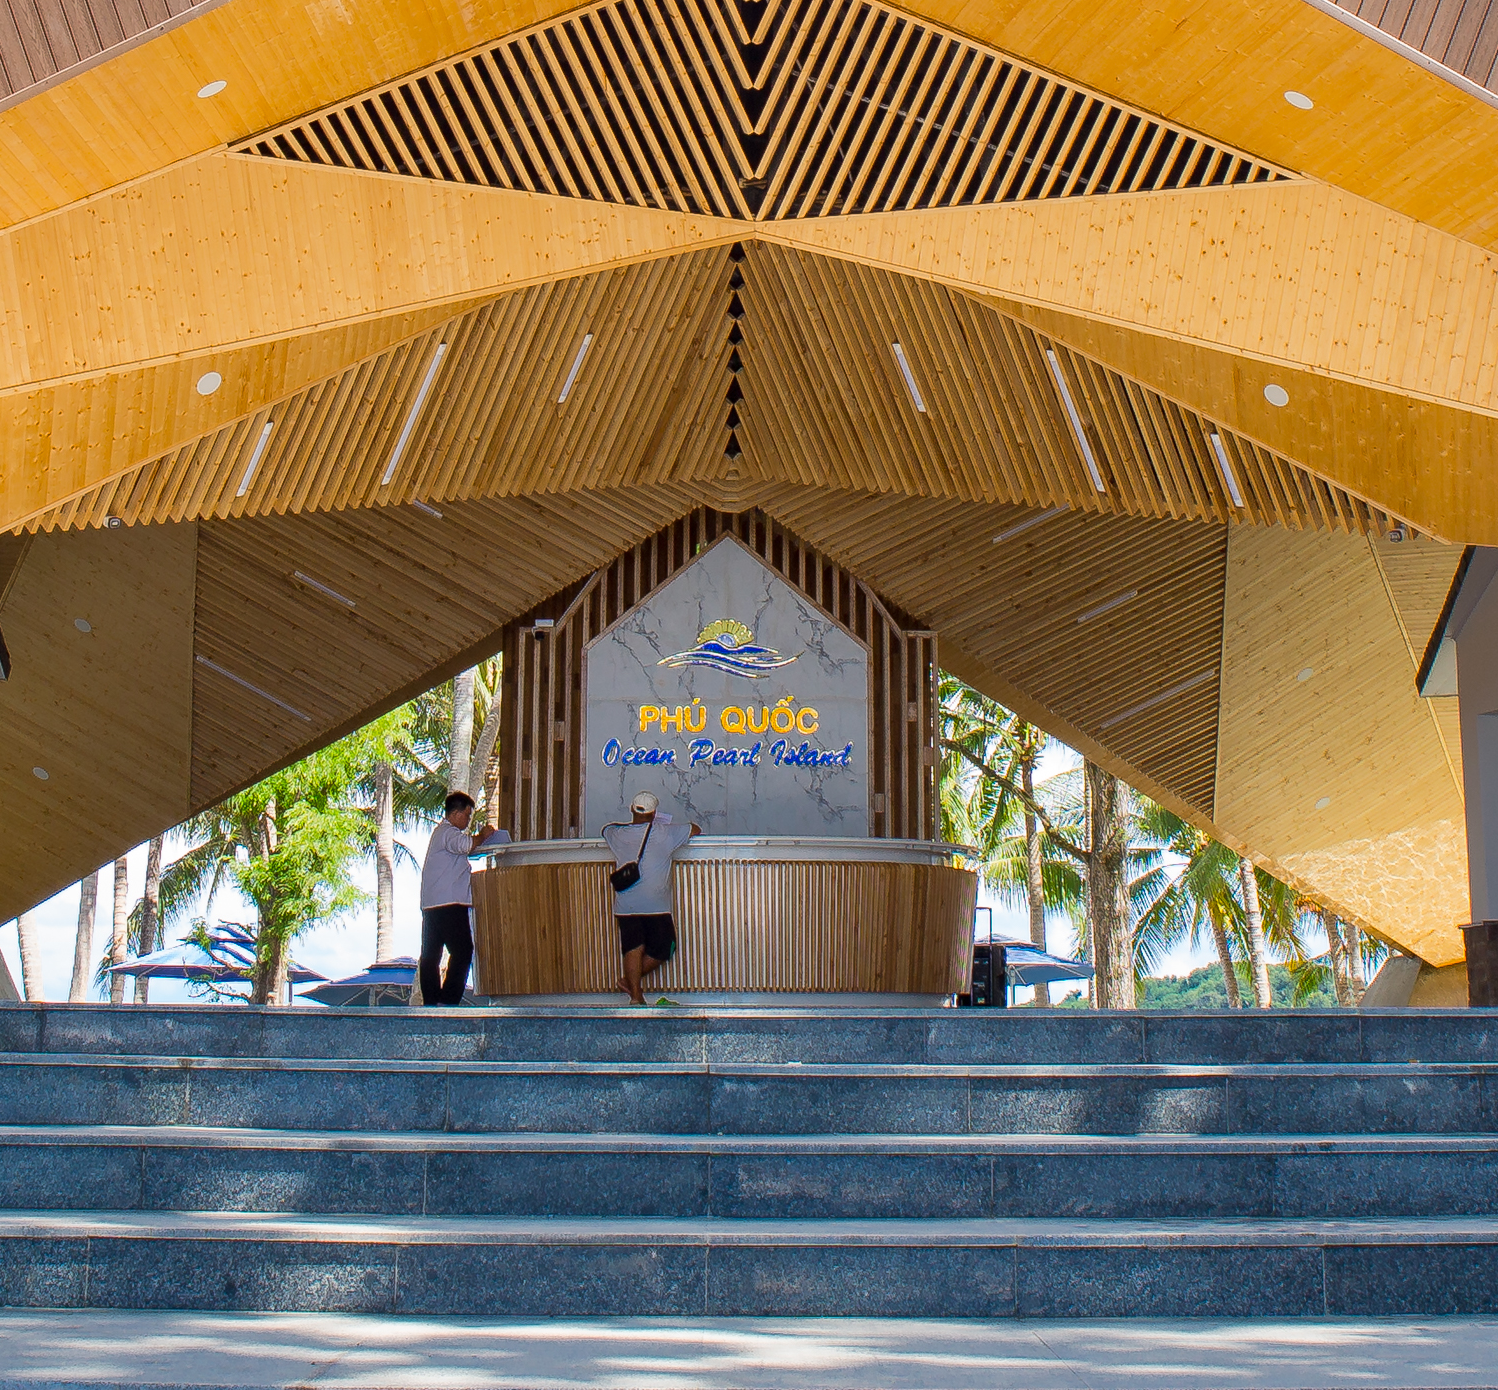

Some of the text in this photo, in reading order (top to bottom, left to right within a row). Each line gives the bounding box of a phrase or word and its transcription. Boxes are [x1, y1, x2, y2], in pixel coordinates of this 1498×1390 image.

[638, 695, 820, 735] PHÚ QUỐC
[600, 737, 854, 768] Ocean Pearl Island
